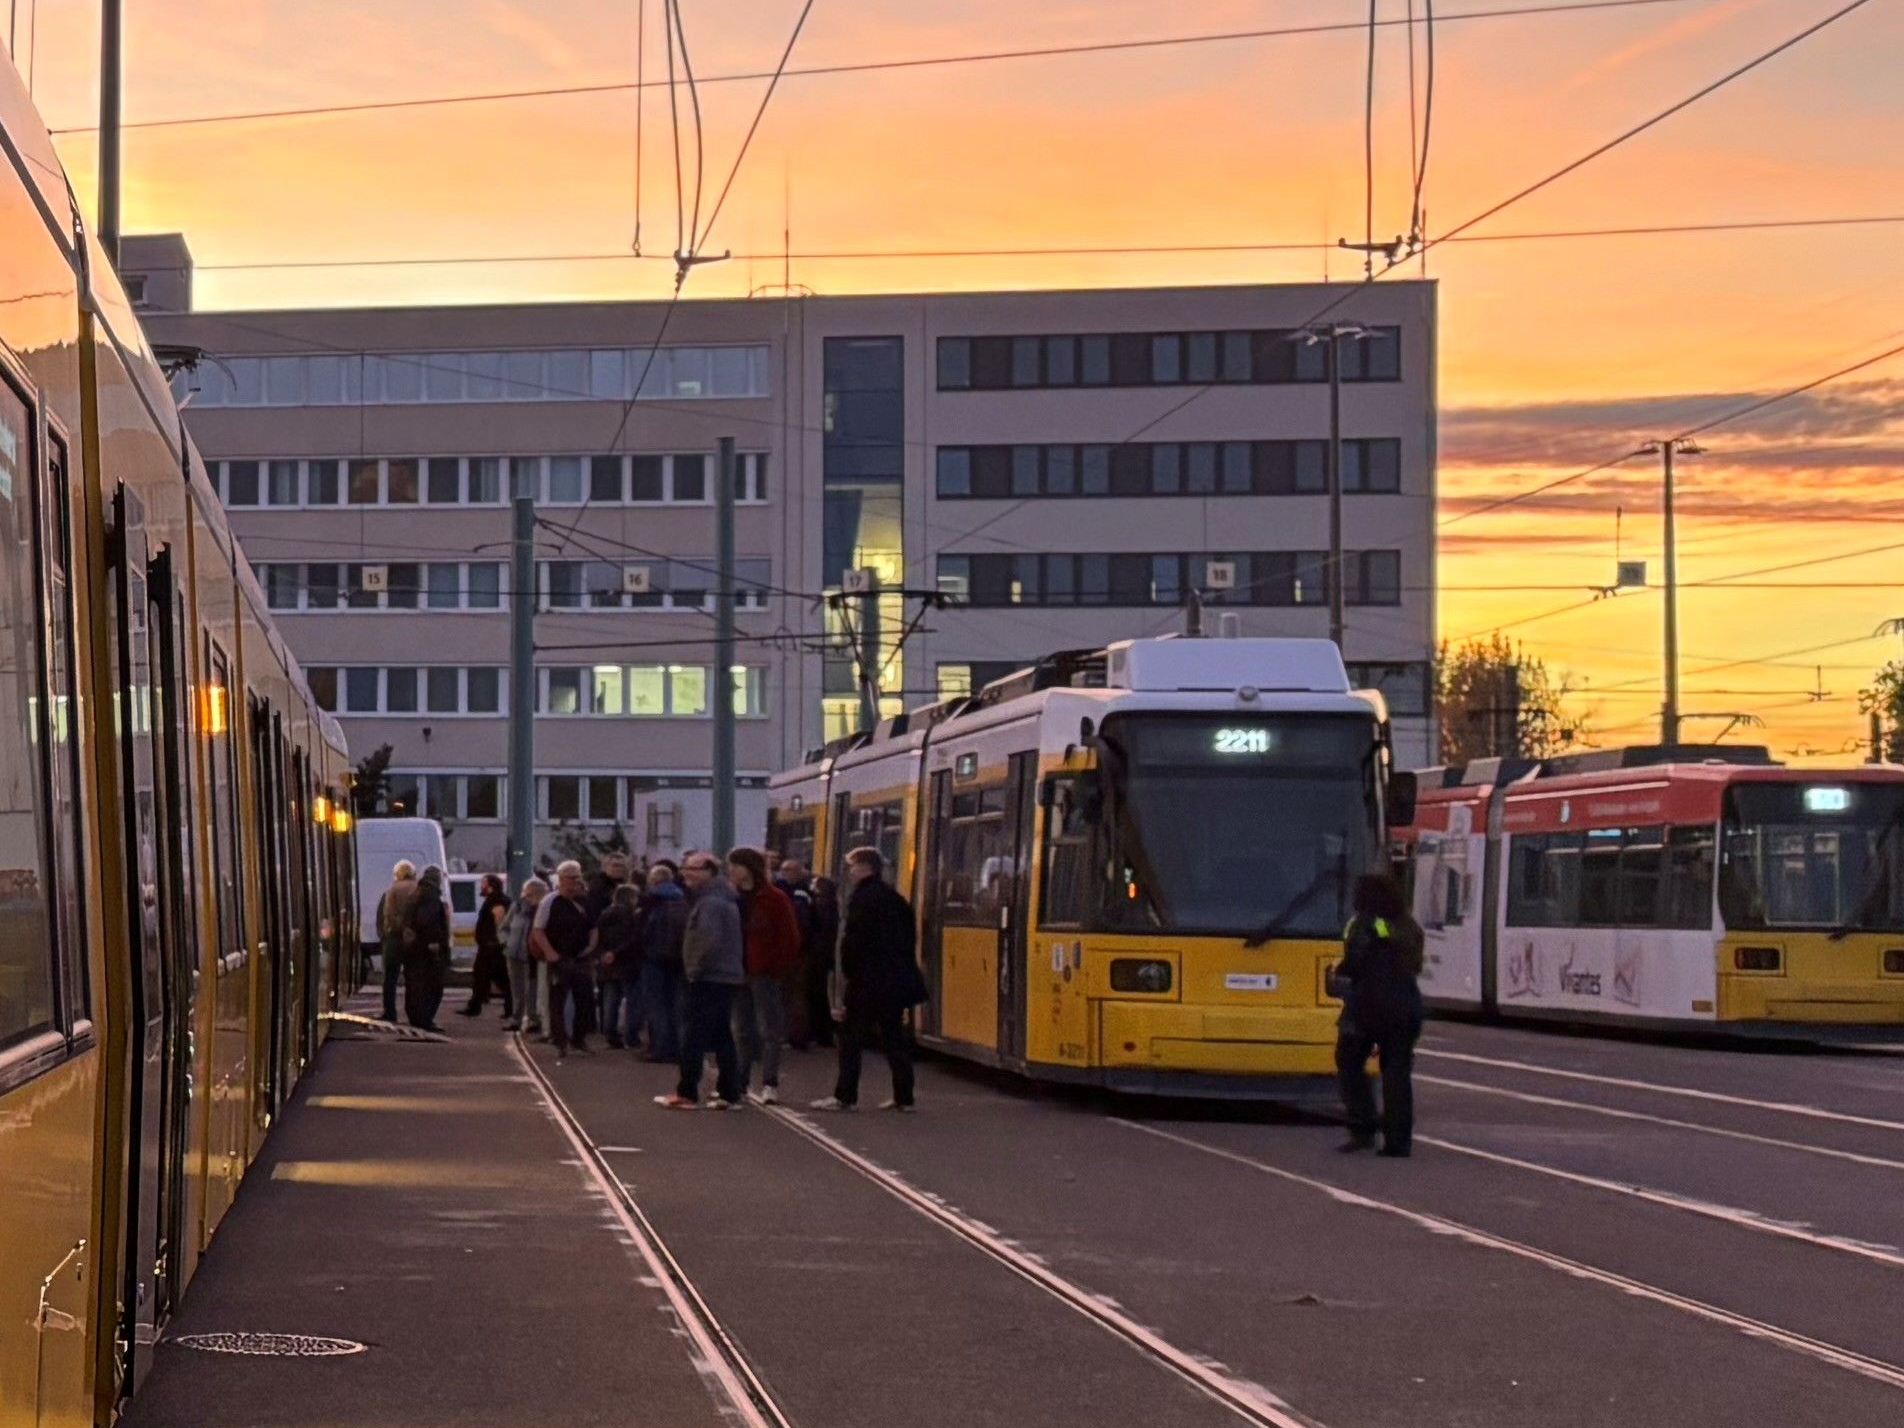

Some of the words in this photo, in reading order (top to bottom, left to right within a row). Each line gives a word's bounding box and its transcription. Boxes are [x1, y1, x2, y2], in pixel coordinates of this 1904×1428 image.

[368, 573, 380, 584] 15
[629, 573, 642, 585] 16
[850, 575, 862, 588] 17
[1215, 728, 1269, 753] 2211
